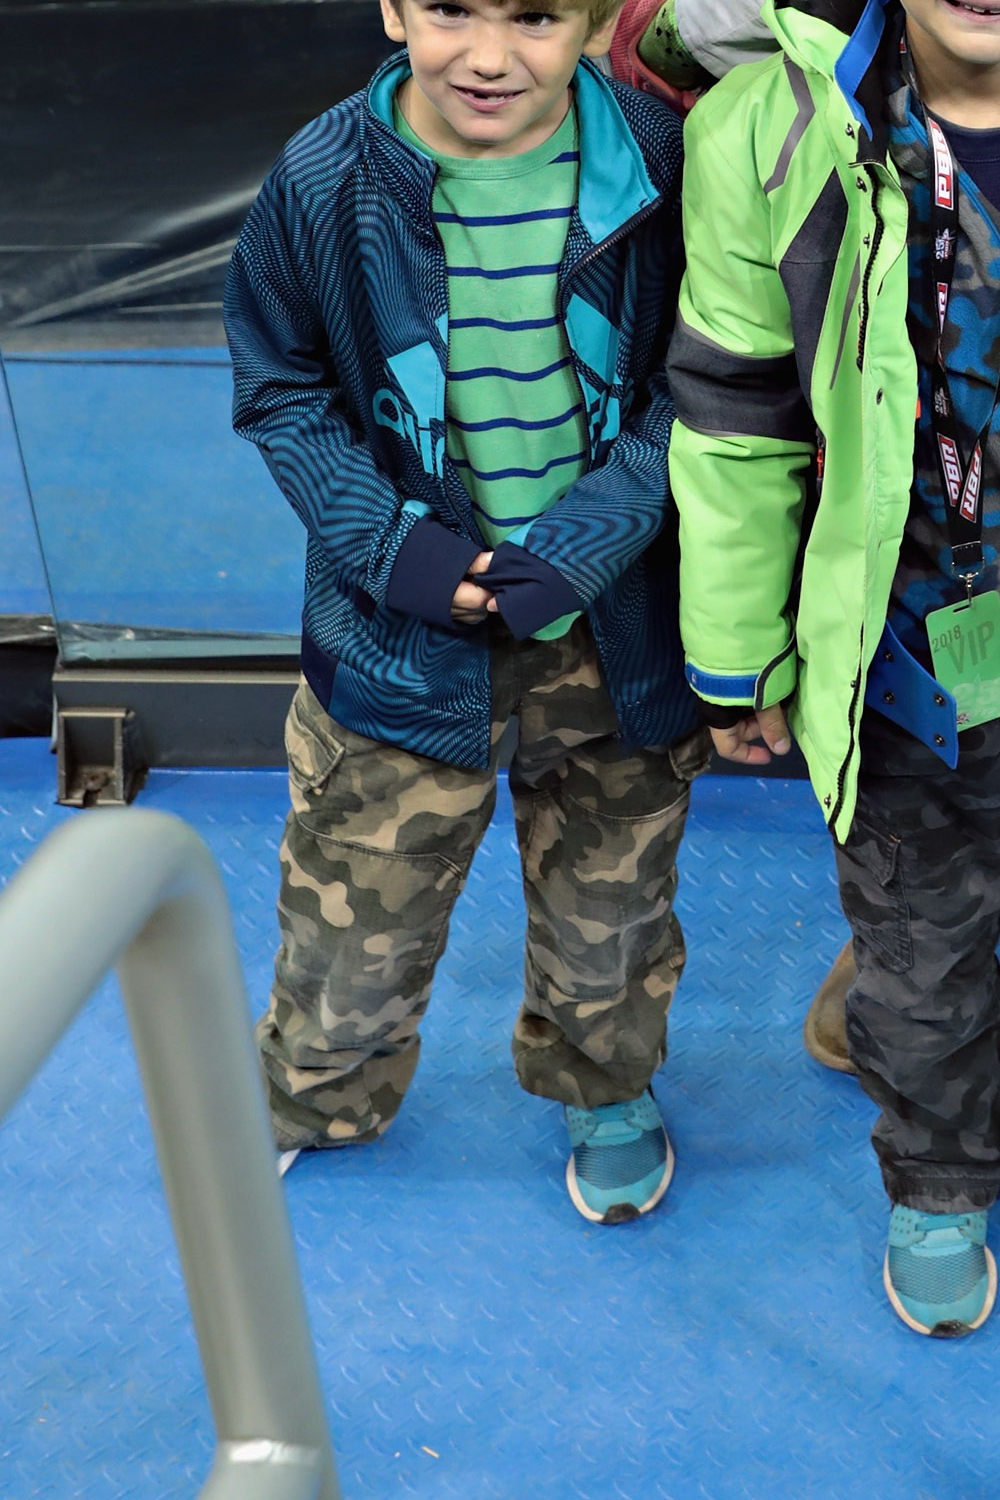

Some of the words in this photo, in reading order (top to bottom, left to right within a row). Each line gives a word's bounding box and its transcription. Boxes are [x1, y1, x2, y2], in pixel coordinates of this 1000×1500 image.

[931, 124, 952, 201] PBR
[940, 440, 963, 501] PBR
[963, 449, 981, 516] PBR
[931, 624, 962, 653] 2018
[945, 620, 995, 674] VIP
